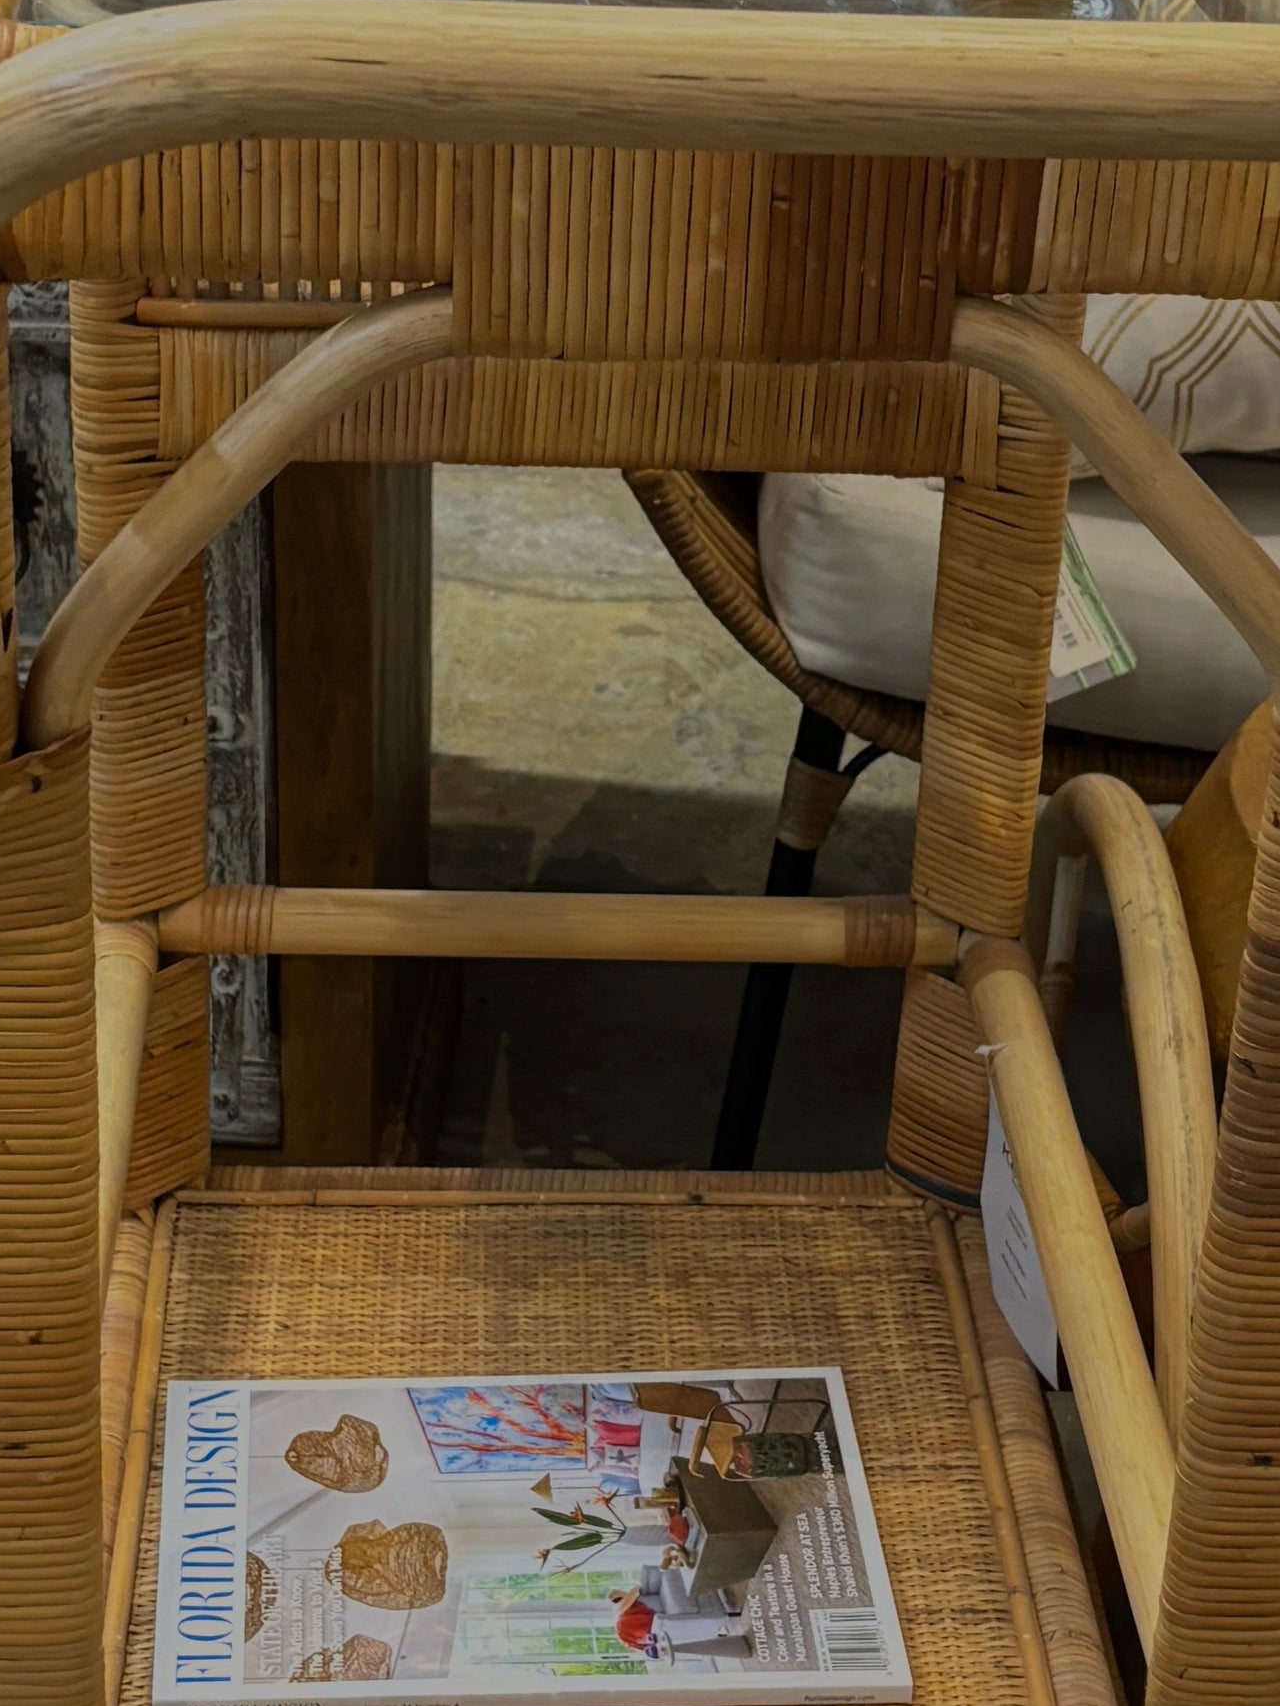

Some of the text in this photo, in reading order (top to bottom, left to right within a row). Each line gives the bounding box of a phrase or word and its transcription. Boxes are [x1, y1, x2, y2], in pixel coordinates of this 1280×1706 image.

[814, 1431, 859, 1598] Shahid Khan's $360 Million Superyacht
[175, 1386, 240, 1686] FLORIDA DESIGN
[814, 1506, 841, 1599] Naples Entrepreneur
[796, 1513, 823, 1599] SPLENDOR AT SEA
[261, 1569, 282, 1599] THE
[310, 1594, 322, 1606] to
[765, 1583, 781, 1616] Texture
[261, 1606, 282, 1625] OF
[290, 1608, 303, 1620] to
[329, 1546, 344, 1672] The Shows You Can't Miss
[778, 1554, 809, 1662] Manalapan Guest House
[748, 1595, 771, 1663] COTTAGE CHIC
[772, 1618, 785, 1636] and
[261, 1628, 282, 1675] STATE
[290, 1655, 303, 1674] The
[310, 1654, 323, 1673] The
[775, 1638, 790, 1663] Color
